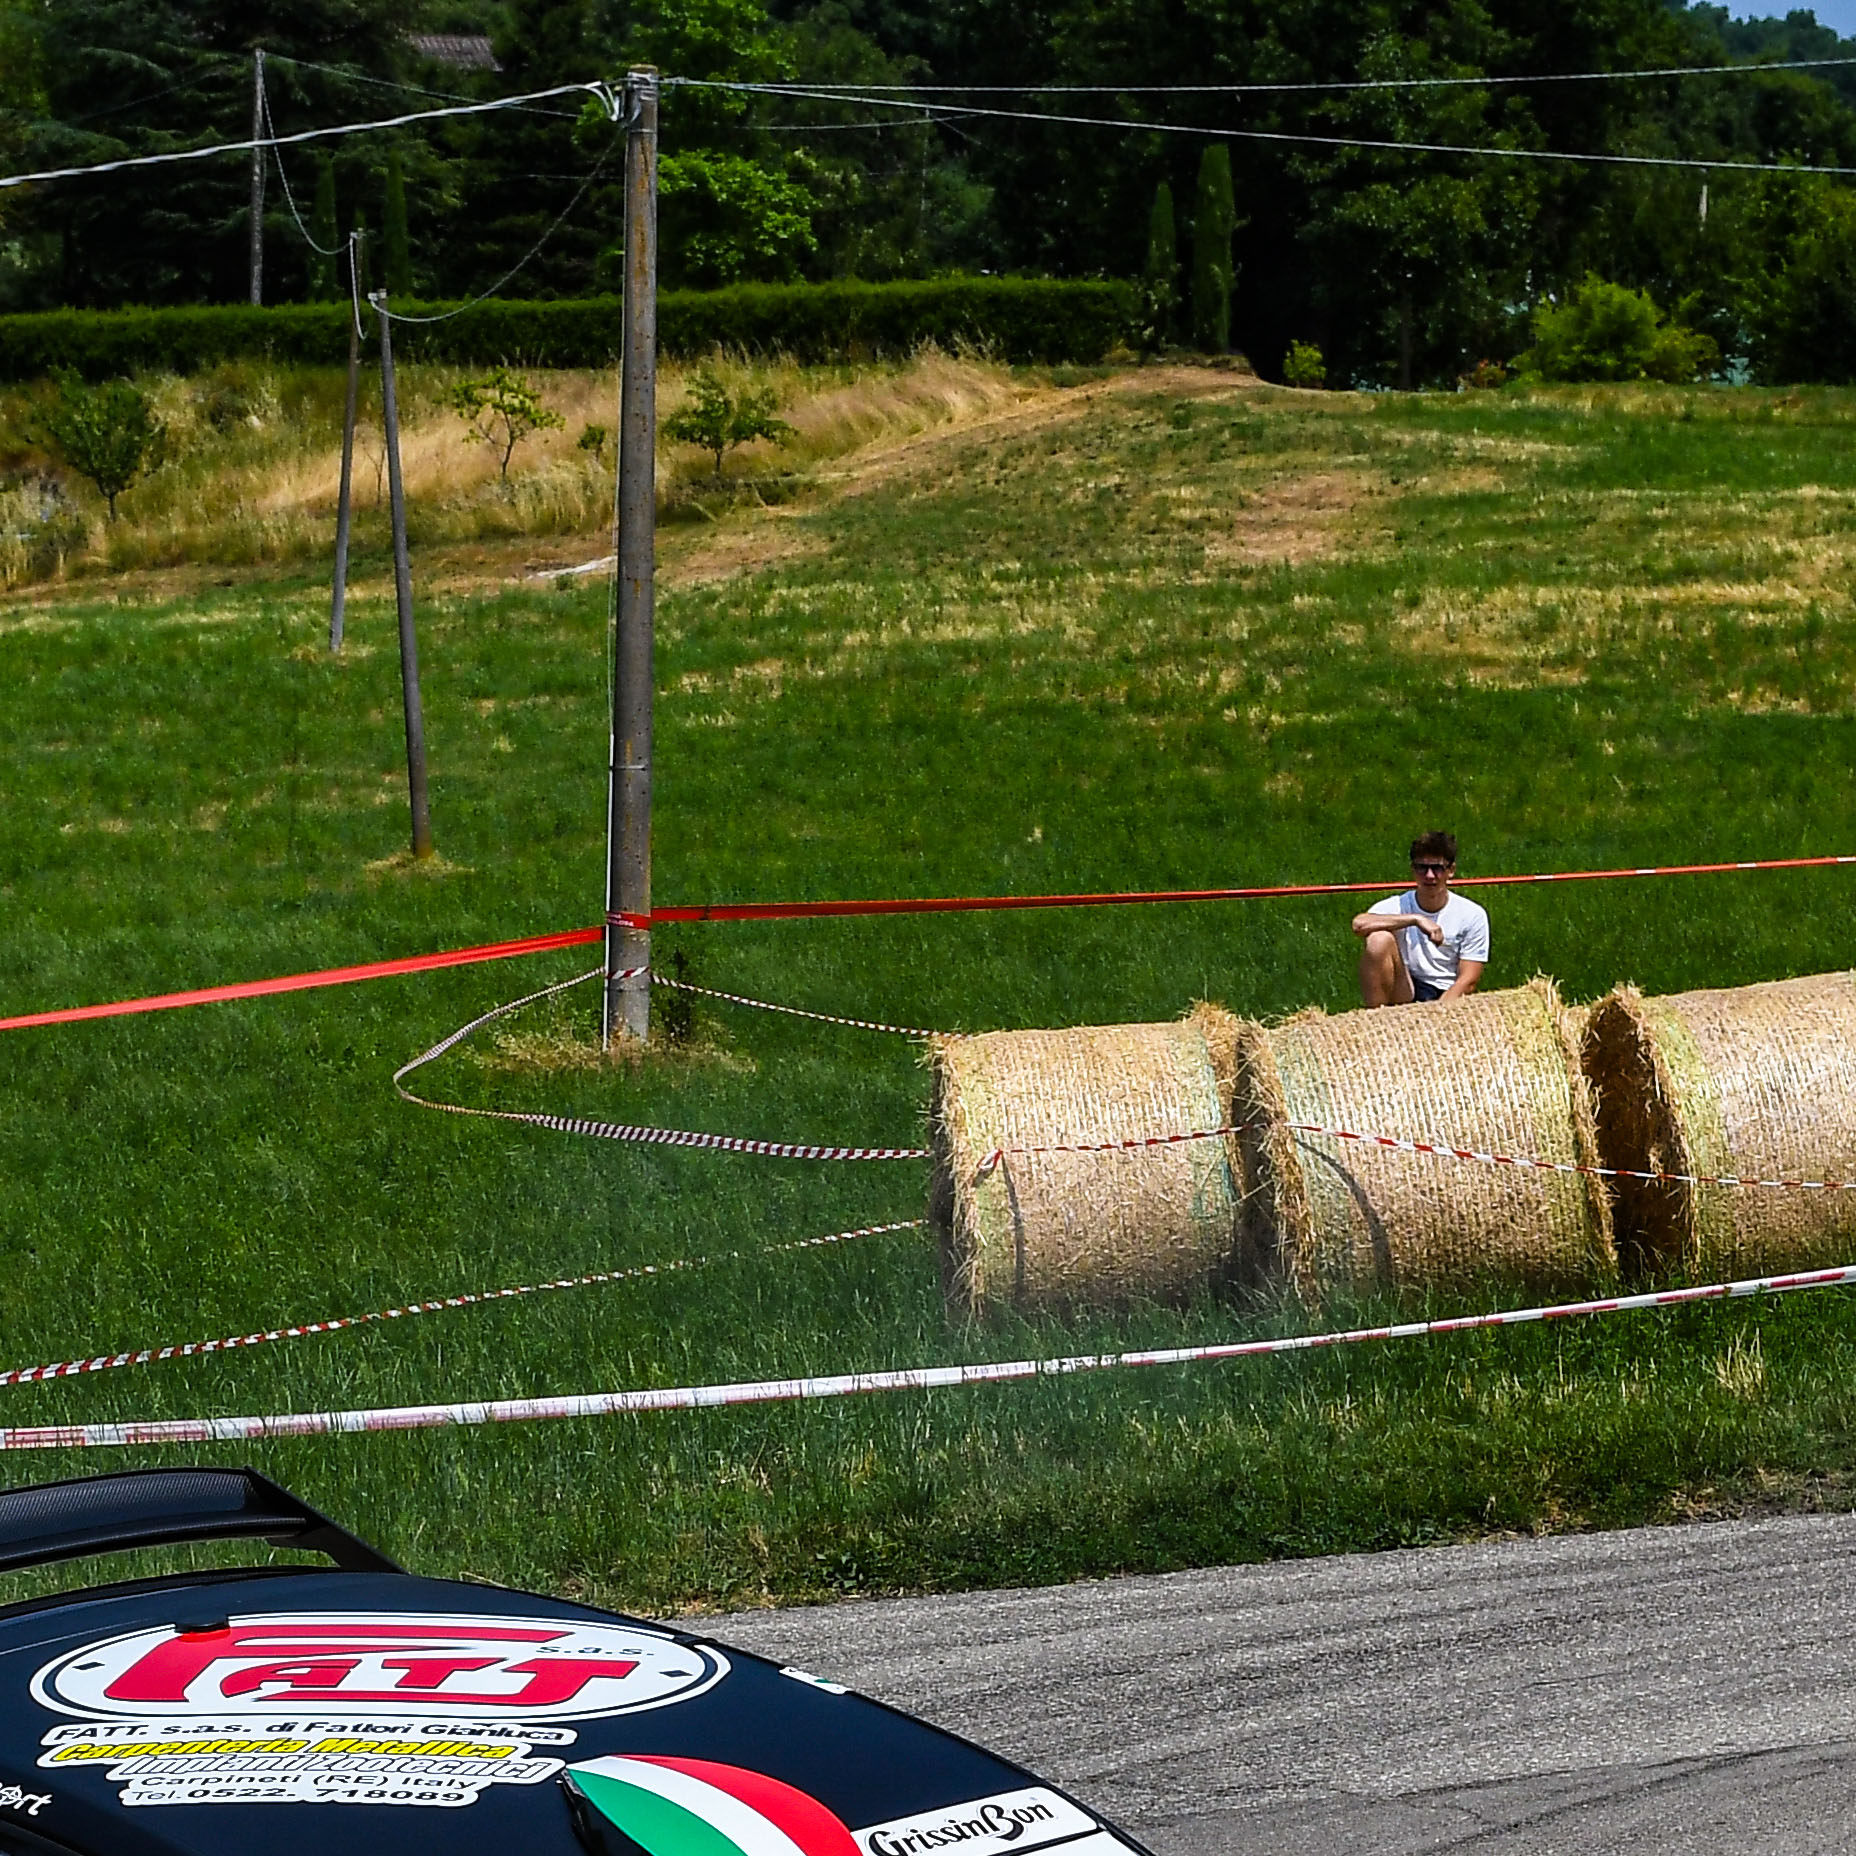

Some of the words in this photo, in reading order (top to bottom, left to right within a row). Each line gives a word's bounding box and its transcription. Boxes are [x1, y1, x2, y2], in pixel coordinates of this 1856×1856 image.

[539, 1644, 654, 1657] s.a.s.
[56, 1722, 148, 1742] FATT.
[162, 1723, 251, 1736] s.a.s.
[265, 1720, 295, 1734] di
[301, 1721, 414, 1737] Fattori
[421, 1722, 565, 1743] Gianluca
[53, 1736, 308, 1762] Carpenteria
[314, 1738, 517, 1759] Metallica
[123, 1752, 310, 1777] Impianti
[310, 1754, 552, 1780] Zootecnici
[141, 1774, 301, 1790] Carpineti
[312, 1773, 389, 1788] (RE)
[401, 1775, 479, 1791] Italy
[133, 1790, 183, 1803] Tel.
[187, 1787, 296, 1800] 0522.
[316, 1788, 465, 1803] 718089
